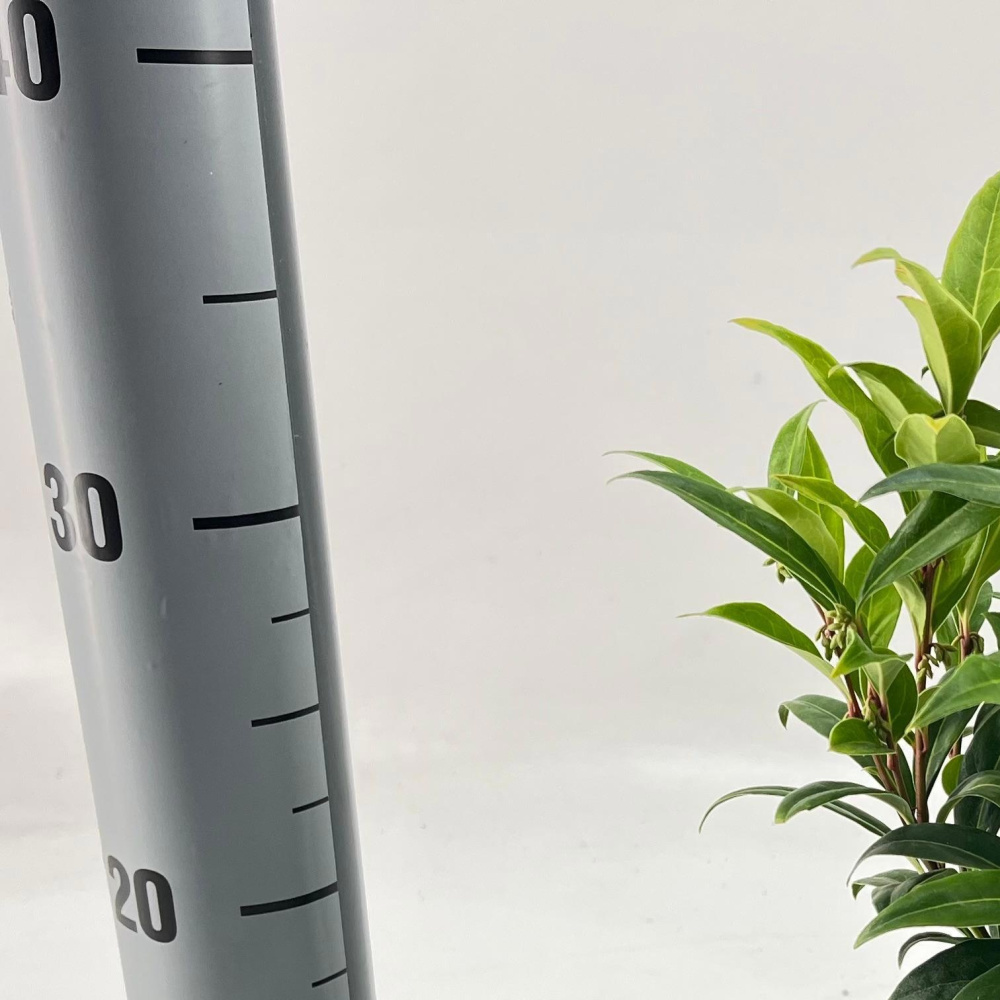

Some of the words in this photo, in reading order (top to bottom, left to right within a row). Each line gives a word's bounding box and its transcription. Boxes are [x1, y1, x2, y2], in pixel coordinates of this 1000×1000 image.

[0, 0, 61, 101] 0
[43, 463, 123, 562] 30
[107, 855, 177, 943] 20
